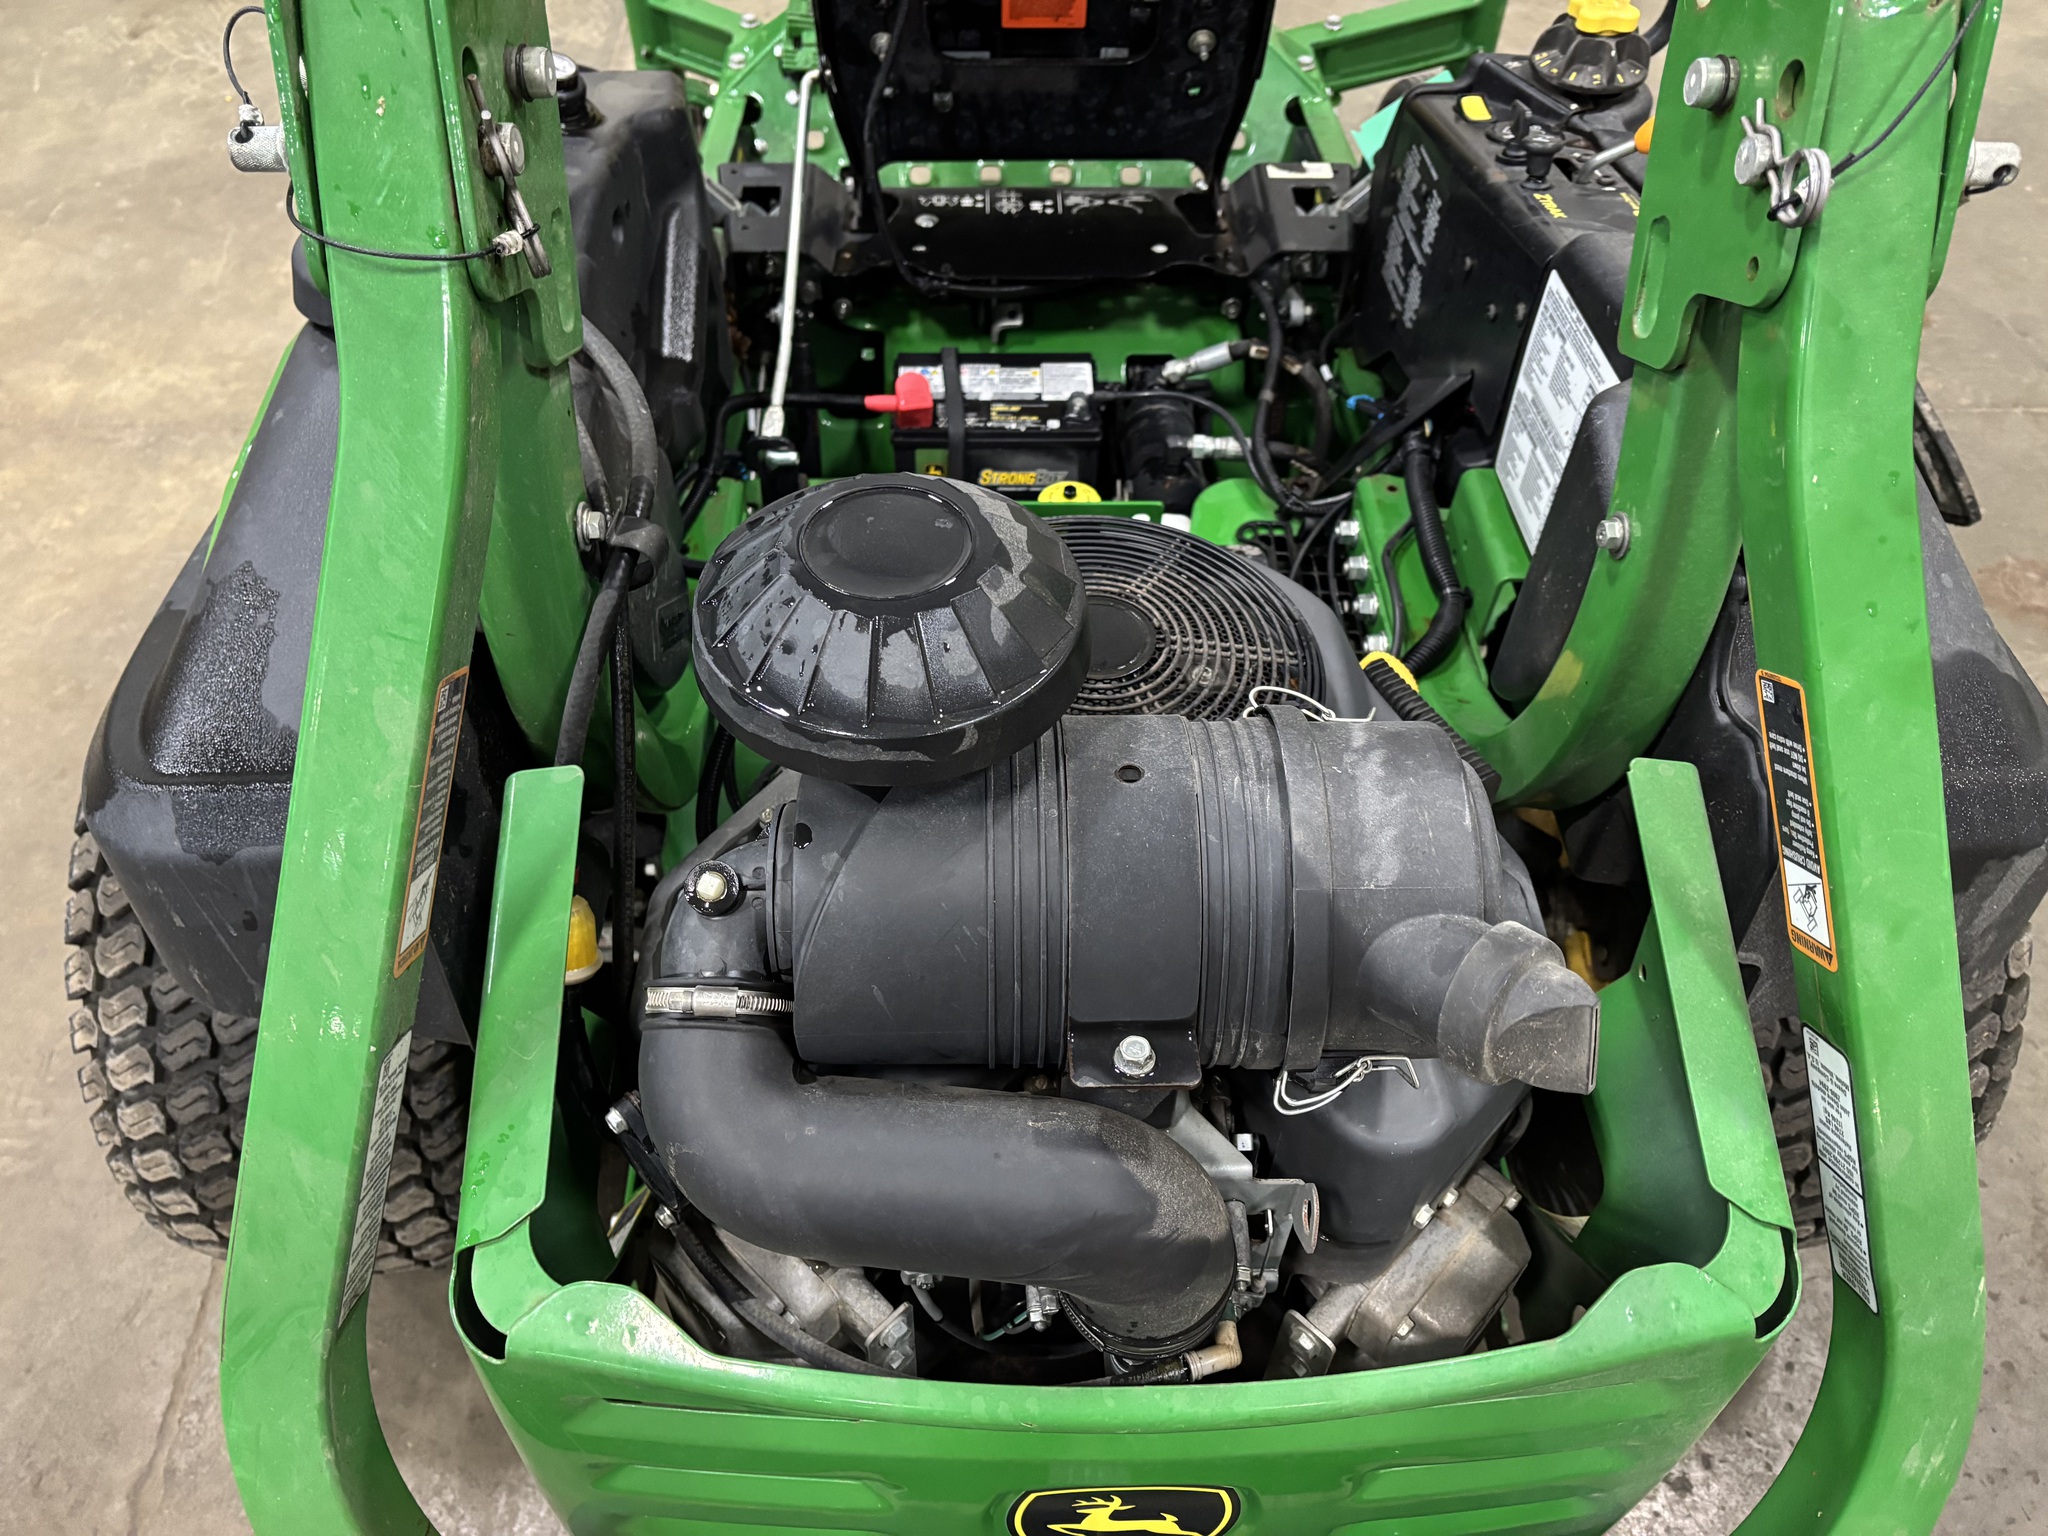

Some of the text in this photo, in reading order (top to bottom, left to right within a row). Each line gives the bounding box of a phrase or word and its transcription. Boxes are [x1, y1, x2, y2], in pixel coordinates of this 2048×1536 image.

[1777, 734, 1785, 743] extra
[1793, 741, 1802, 751] Drive
[1798, 754, 1803, 763] DO
[1792, 761, 1801, 771] down
[1774, 762, 1808, 784] When structure must
[1793, 802, 1806, 814] machine
[1790, 819, 1804, 832] extended
[1806, 818, 1811, 826] Do
[1807, 847, 1815, 857] Keep
[1782, 844, 1820, 874] AVOID CRUSHING
[1791, 929, 1825, 960] WARNING
